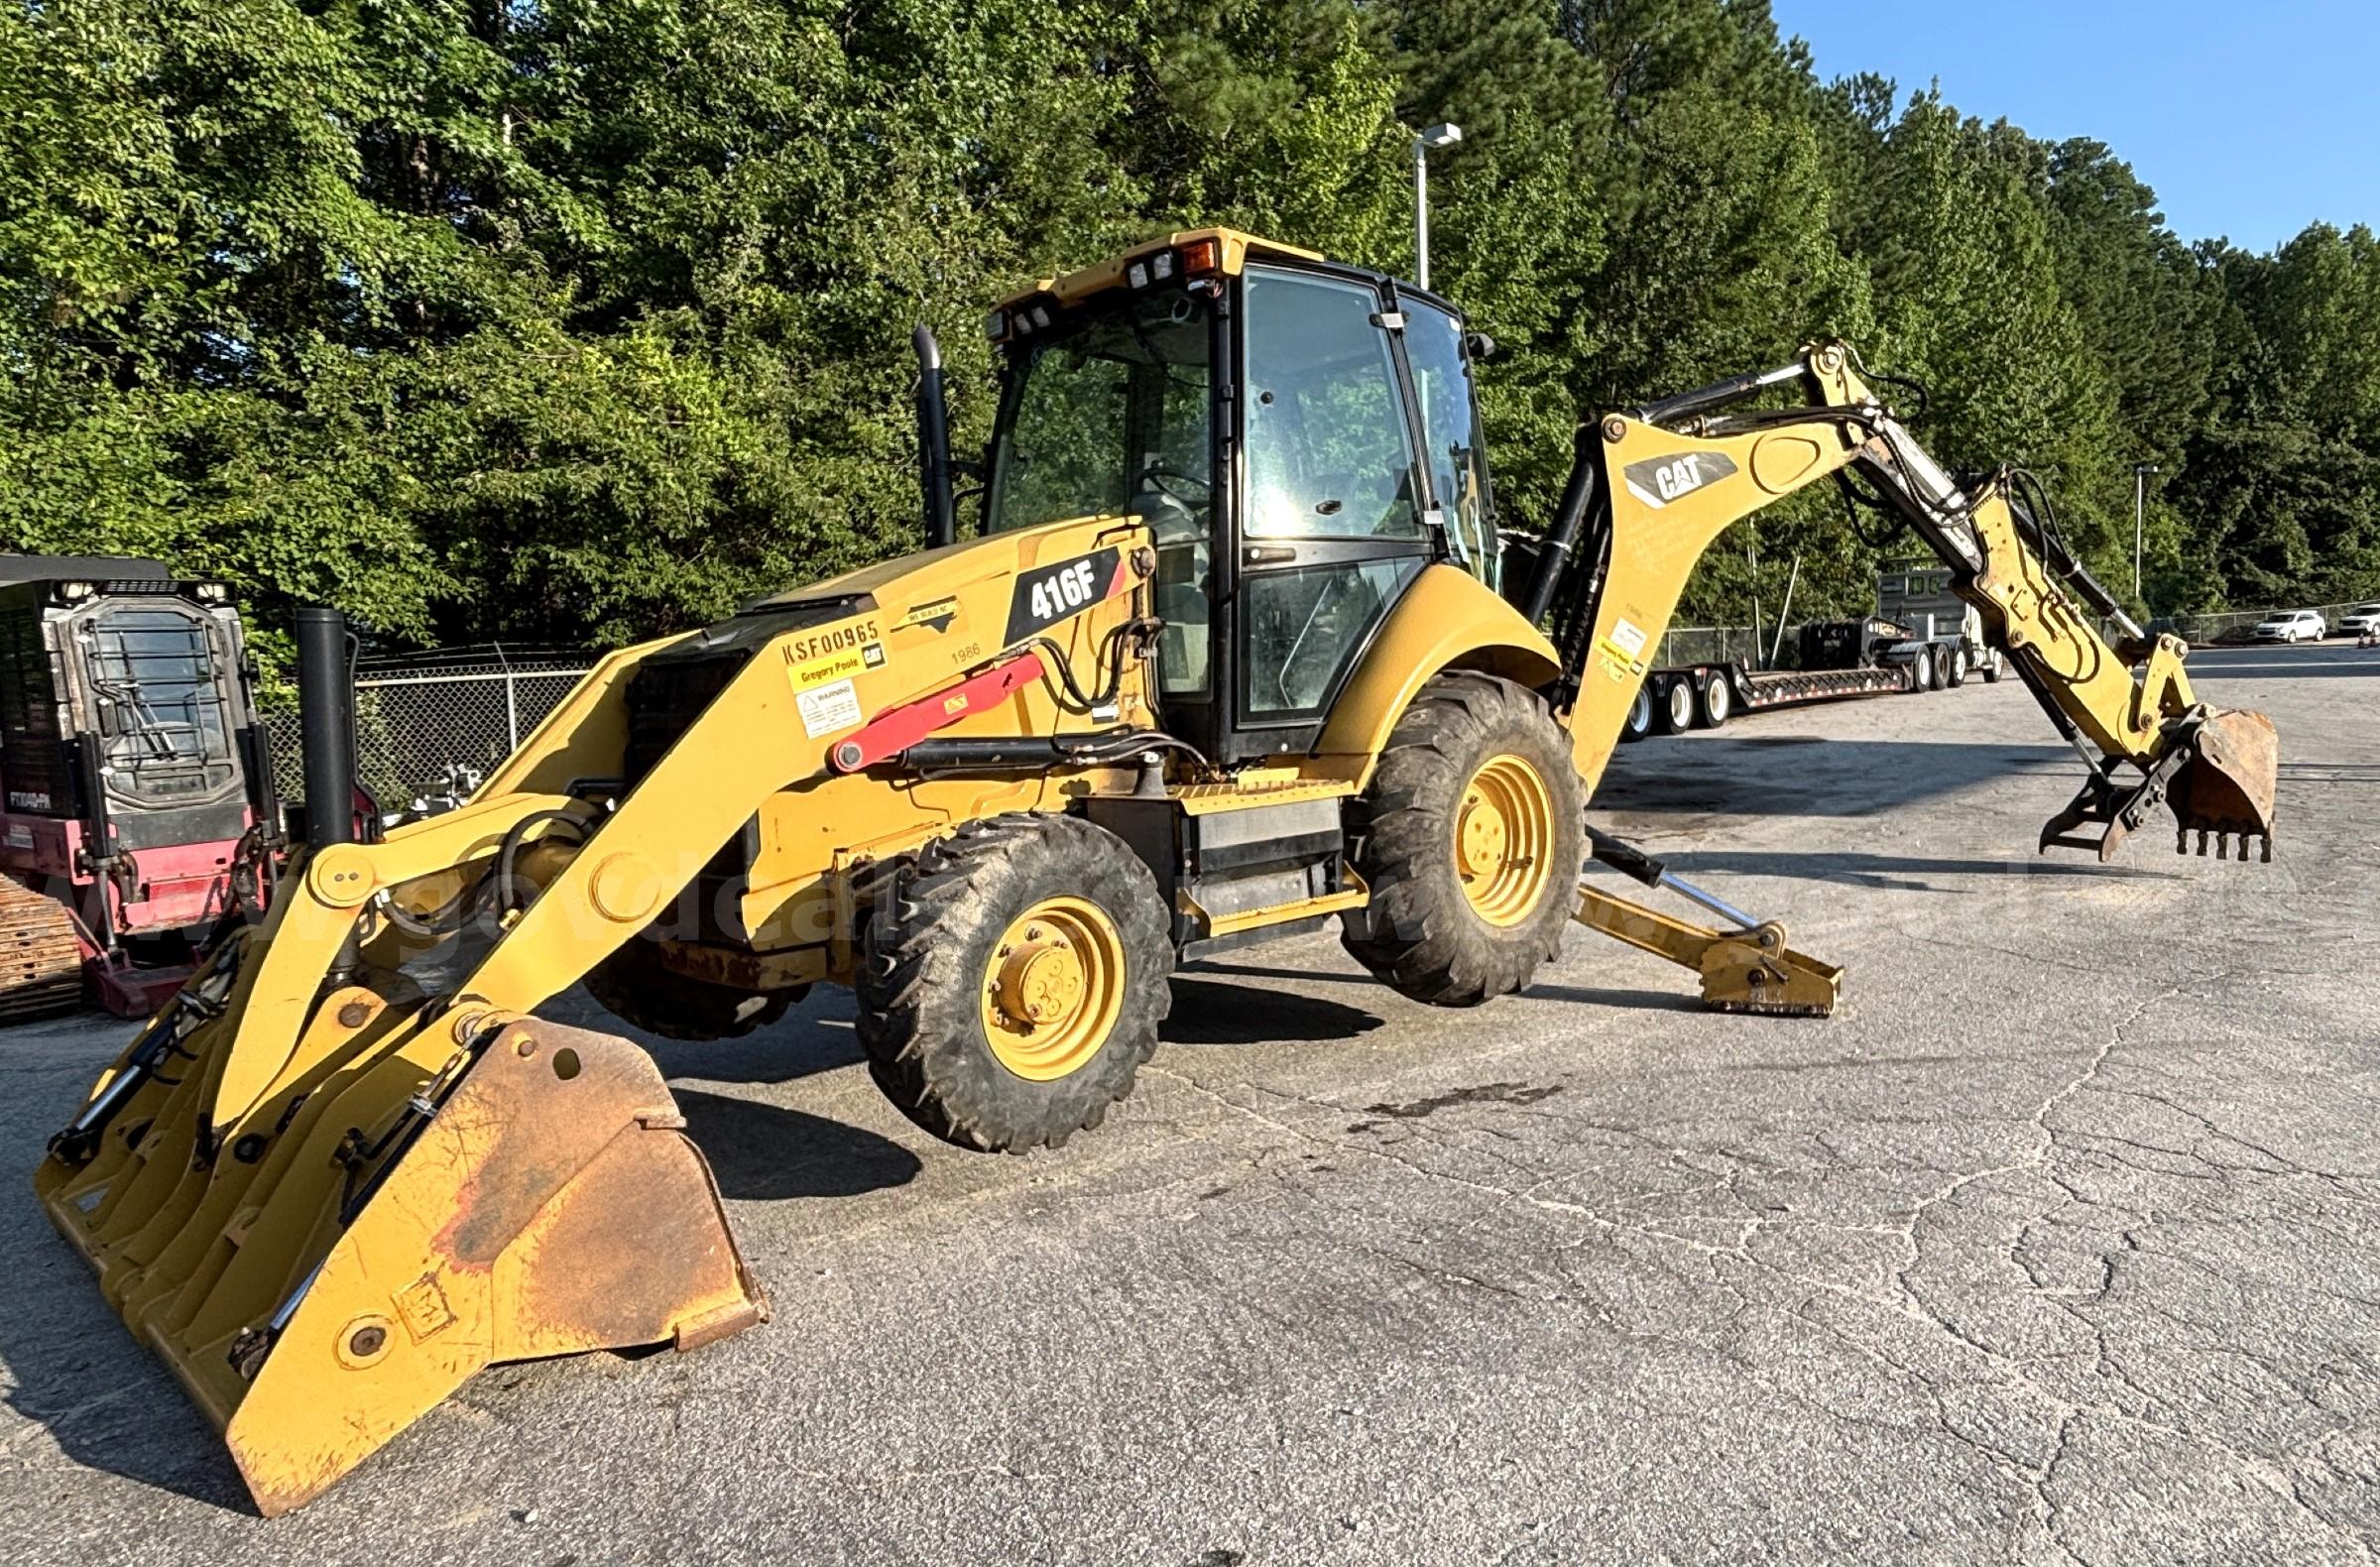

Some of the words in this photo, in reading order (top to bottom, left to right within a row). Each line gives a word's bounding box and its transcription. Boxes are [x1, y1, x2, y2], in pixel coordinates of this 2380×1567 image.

[1654, 453, 1702, 501] CAT
[1029, 559, 1096, 620] 416F
[781, 620, 879, 665] KSF00965
[951, 642, 981, 664] 1986
[800, 665, 834, 682] Gregory
[836, 658, 859, 671] Poole
